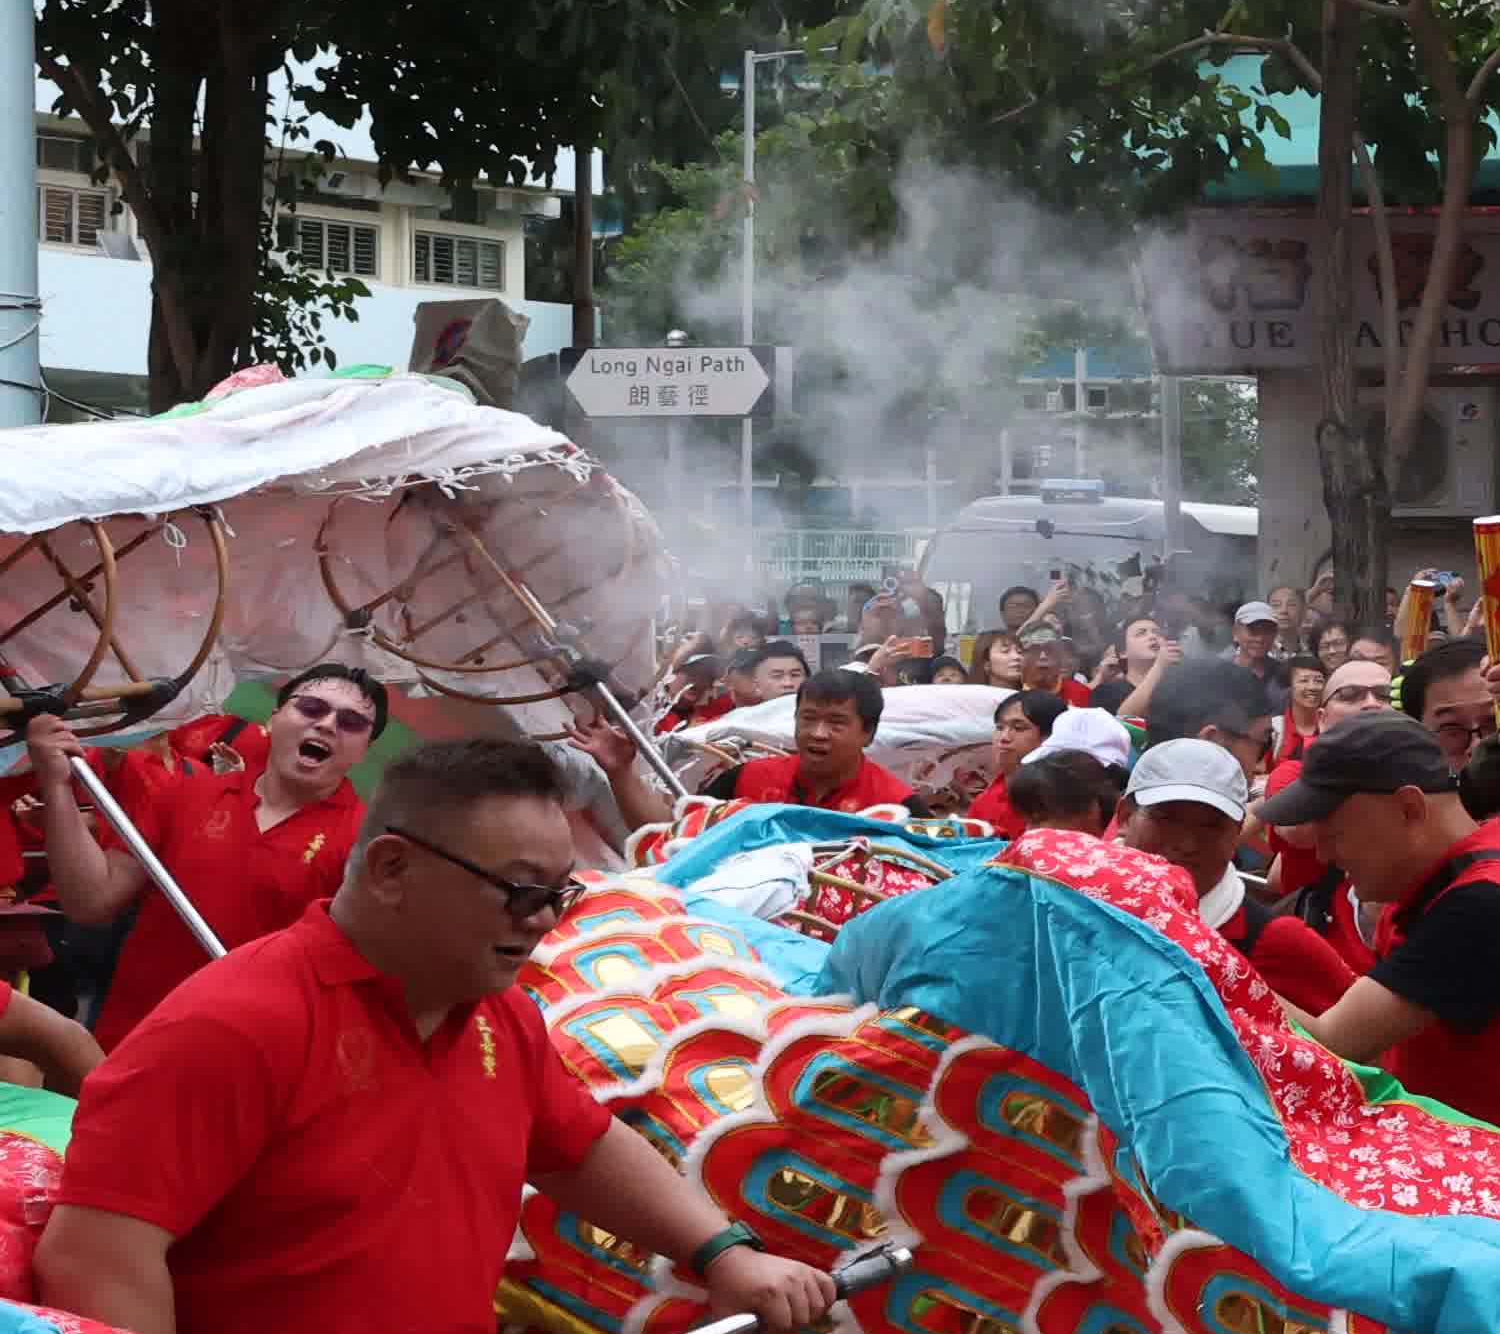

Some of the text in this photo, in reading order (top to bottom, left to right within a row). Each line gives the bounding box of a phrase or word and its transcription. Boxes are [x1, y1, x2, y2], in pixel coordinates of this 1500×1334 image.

[591, 355, 745, 377] Long Ngai Path
[628, 384, 709, 407] 朗藝徑
